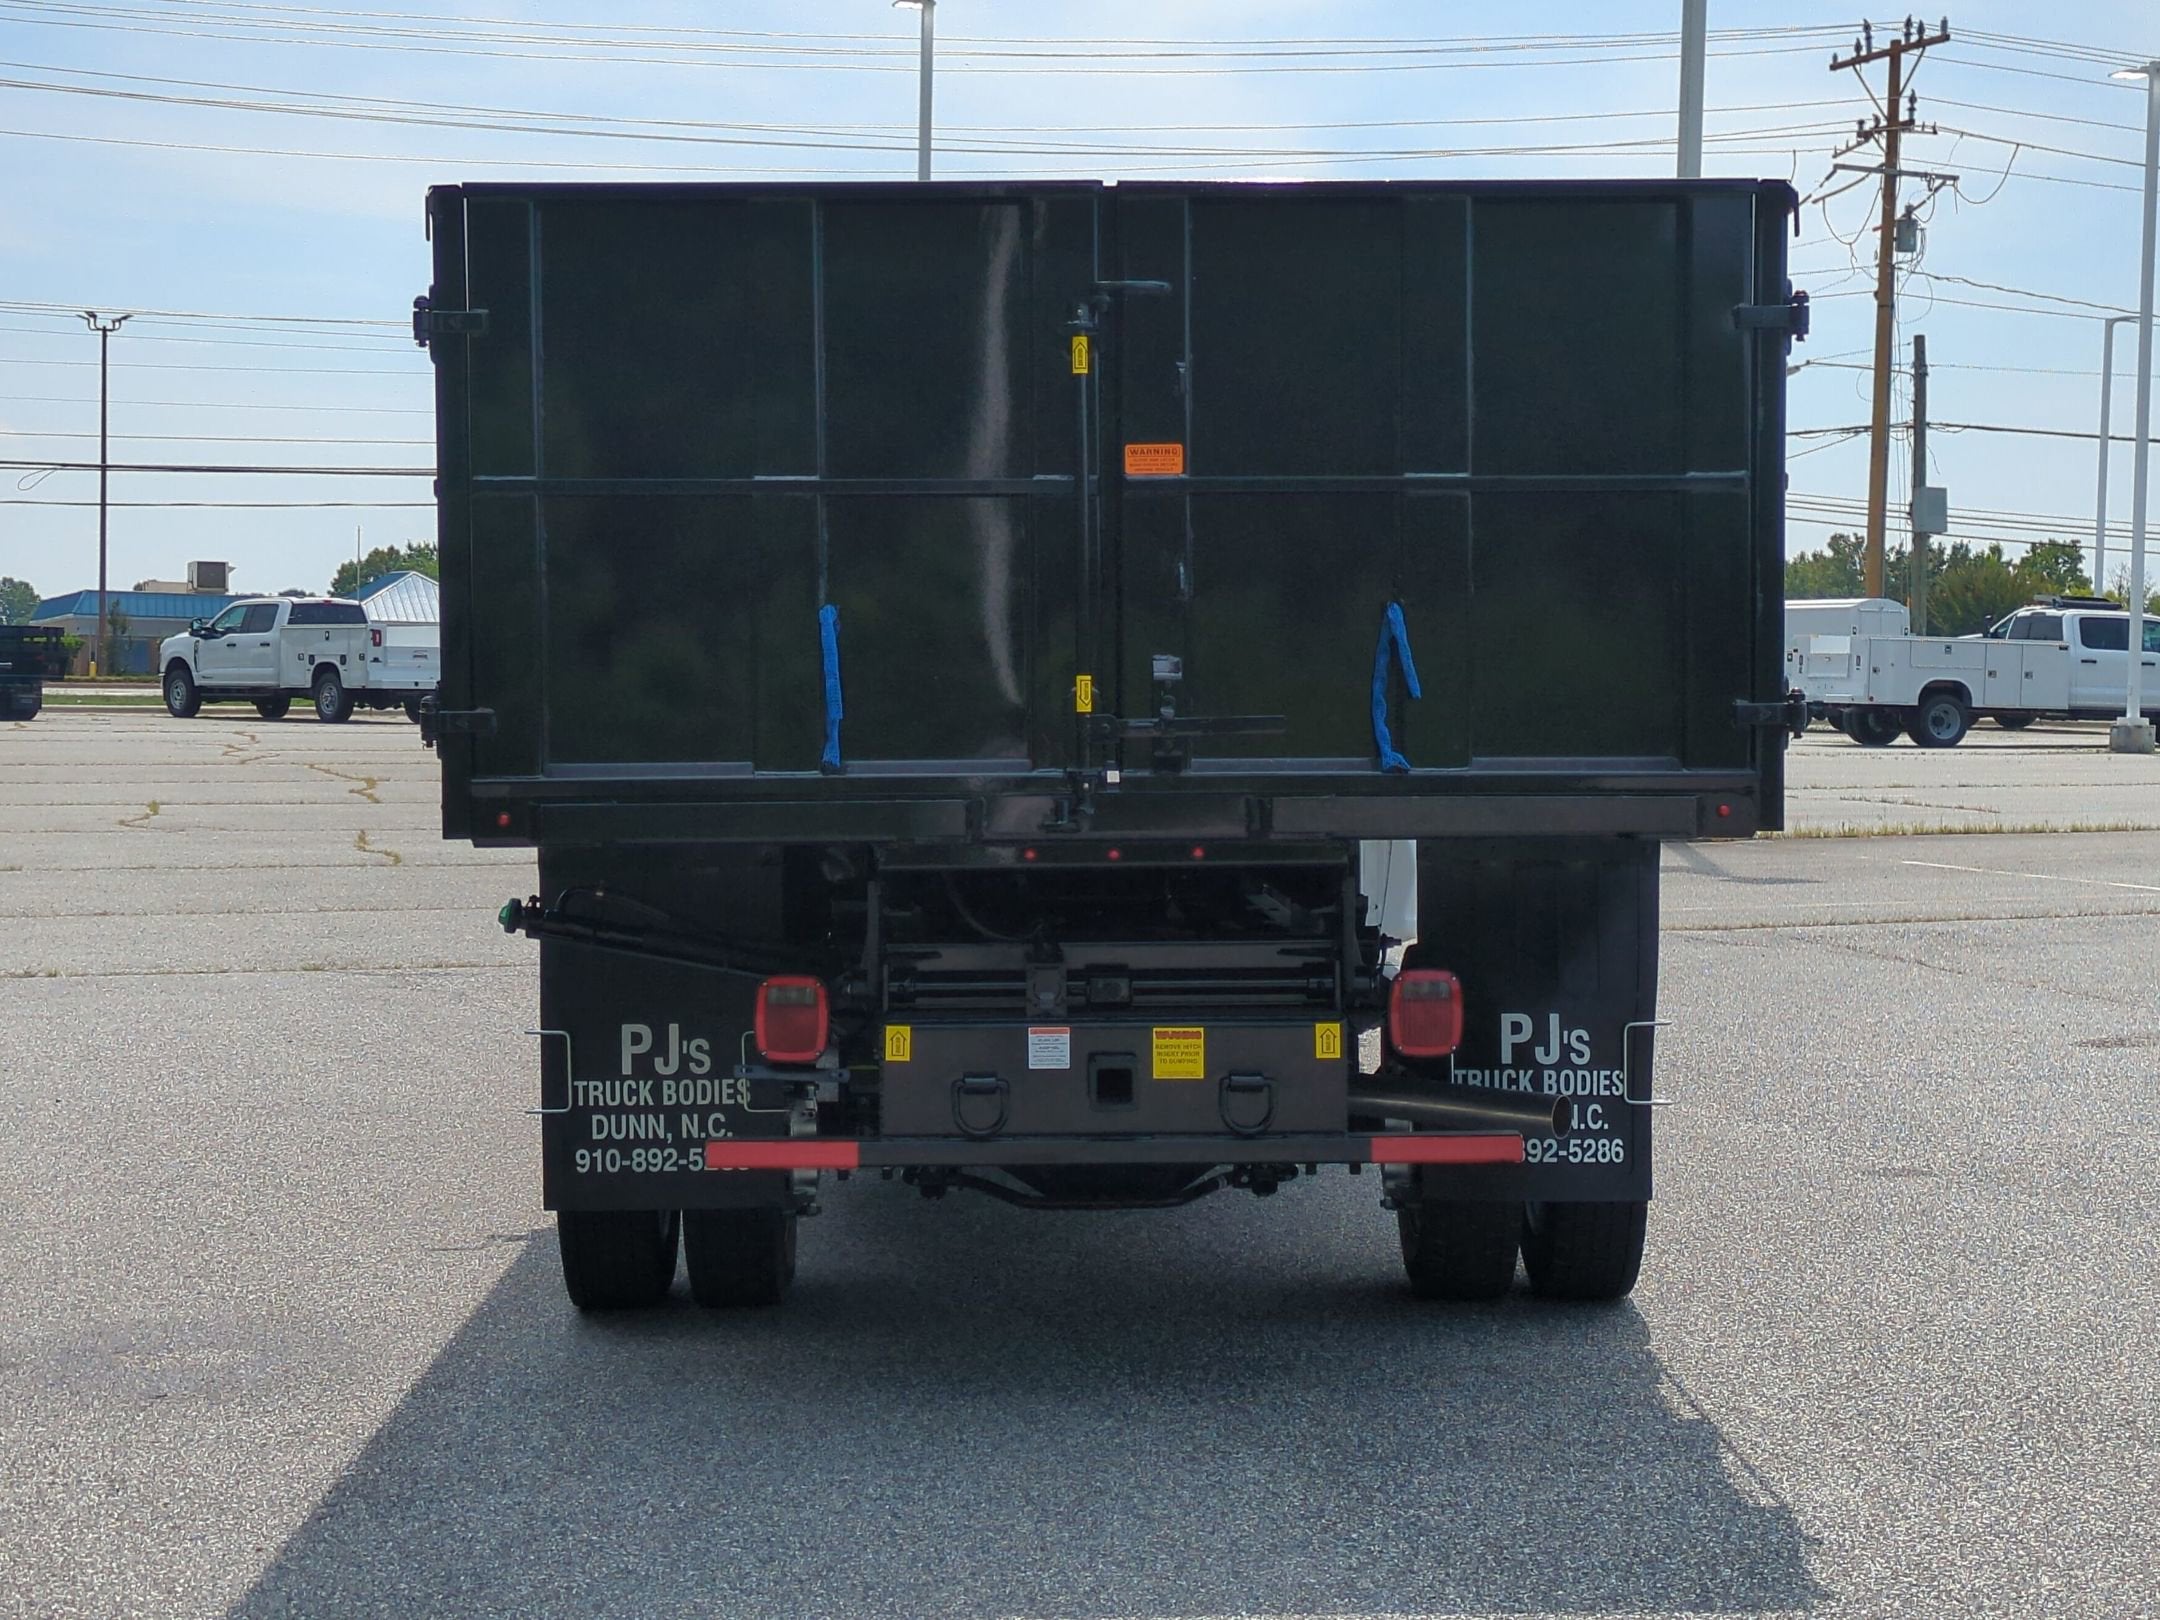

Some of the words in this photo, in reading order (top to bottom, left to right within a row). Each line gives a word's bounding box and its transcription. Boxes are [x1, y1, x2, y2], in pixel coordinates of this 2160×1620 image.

[1129, 448, 1177, 456] WARNING
[574, 1080, 654, 1106] TRUCK
[663, 1079, 751, 1106] BODIES
[1455, 1069, 1533, 1093] TRUCK
[1543, 1069, 1623, 1096] BODIES
[591, 1114, 673, 1143] DUNN,
[681, 1112, 733, 1138] N.C.
[575, 1147, 750, 1173] 910-892-5
[1523, 1138, 1624, 1164] 92-5286
